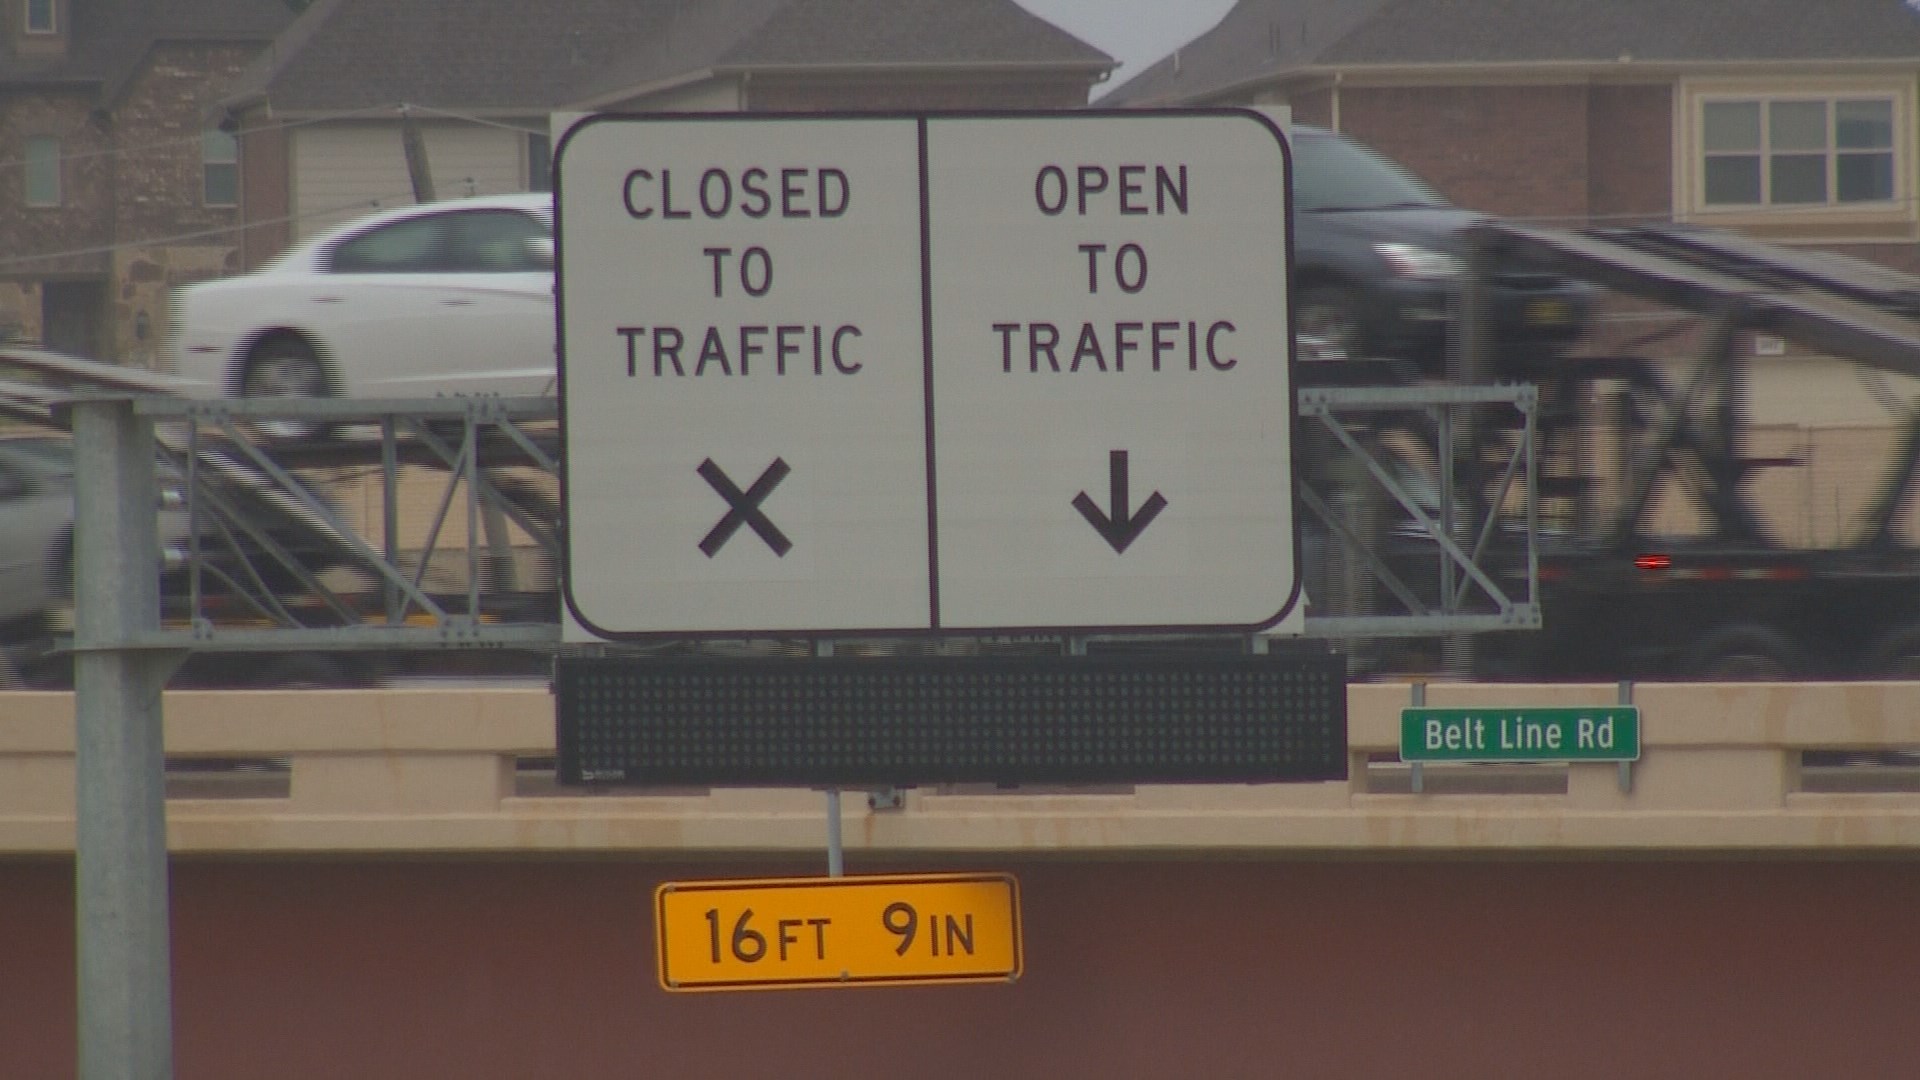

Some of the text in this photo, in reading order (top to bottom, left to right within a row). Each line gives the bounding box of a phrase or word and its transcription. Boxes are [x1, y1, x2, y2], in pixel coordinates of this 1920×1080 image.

[623, 167, 851, 220] CLOSED
[1035, 165, 1189, 216] OPEN
[703, 246, 774, 298] TO
[1078, 243, 1148, 294] TO
[616, 325, 863, 377] TRAFFIC
[992, 321, 1238, 373] TRAFFIC
[1425, 716, 1615, 750] Belt Line Rd
